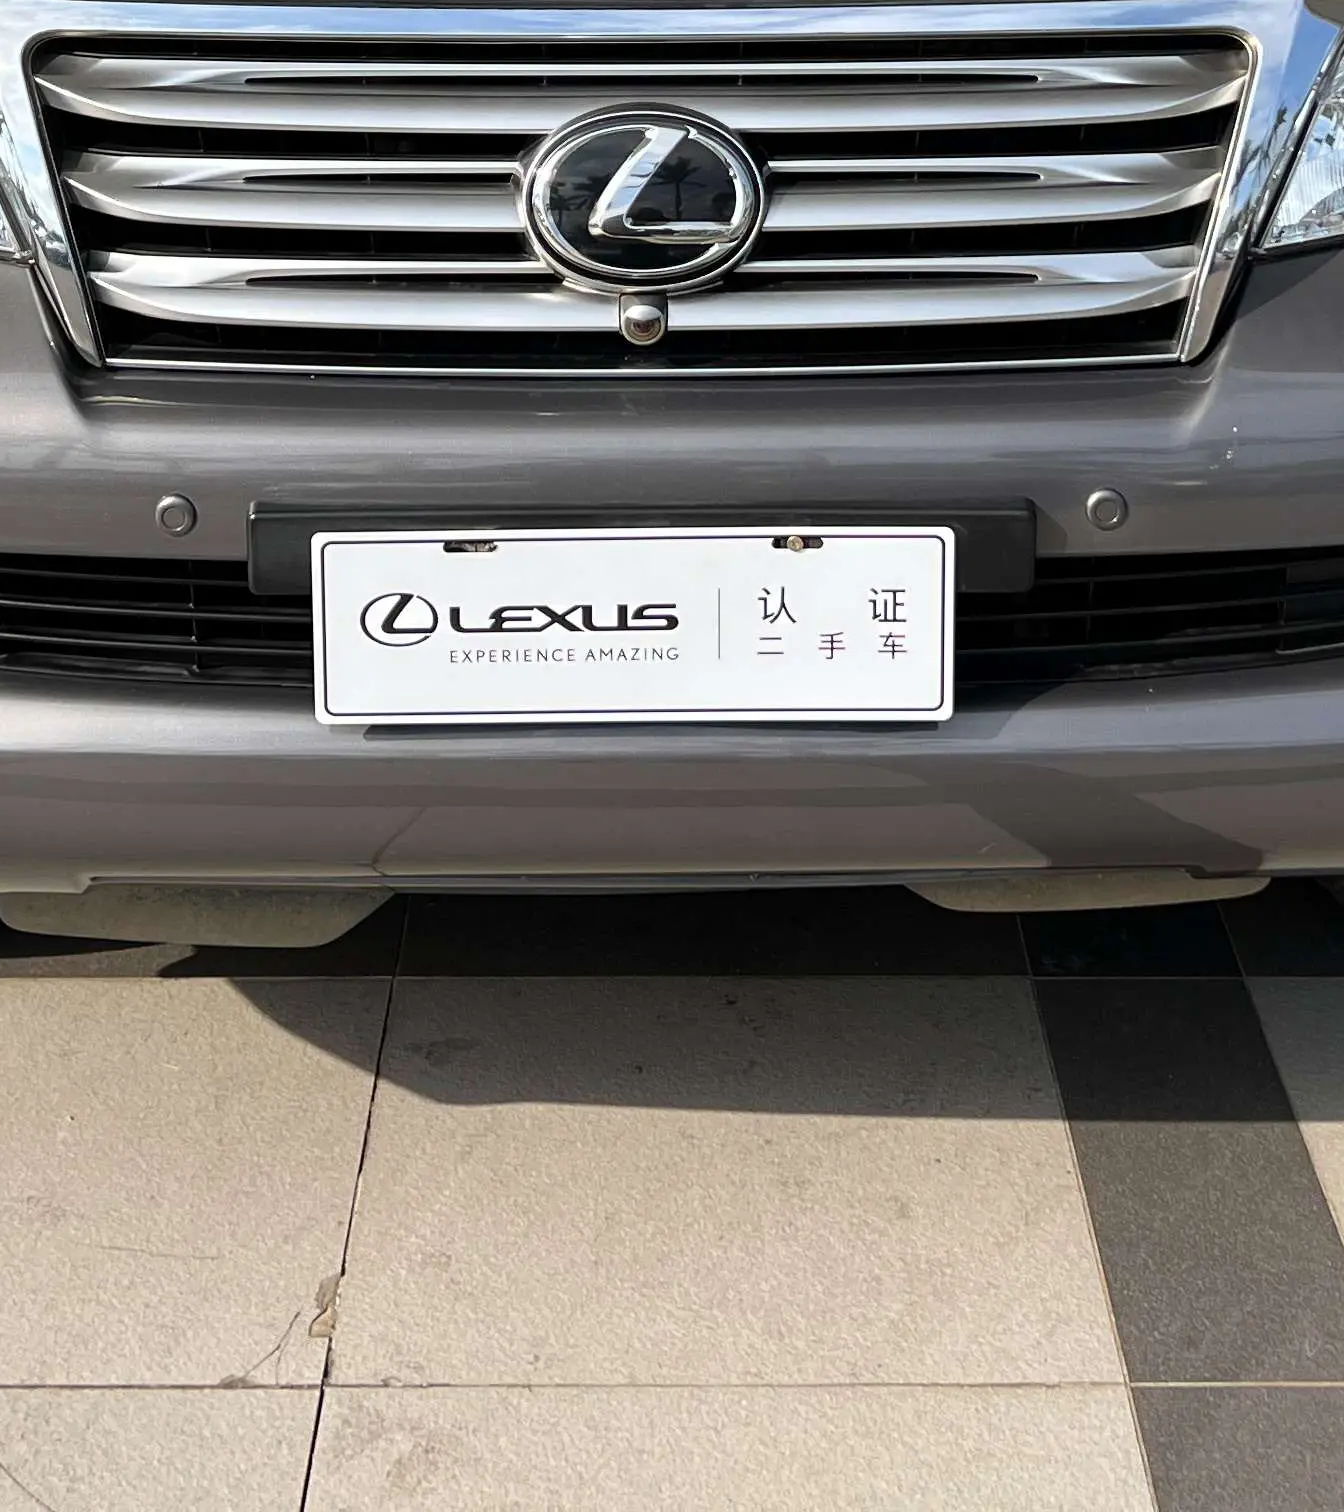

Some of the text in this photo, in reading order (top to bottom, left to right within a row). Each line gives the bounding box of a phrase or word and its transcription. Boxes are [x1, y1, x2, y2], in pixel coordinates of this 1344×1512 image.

[449, 603, 679, 633] LEXUS
[757, 586, 908, 624] 认证
[449, 647, 680, 663] EXPERIENCE AMAZING
[757, 631, 908, 660] 二手车
